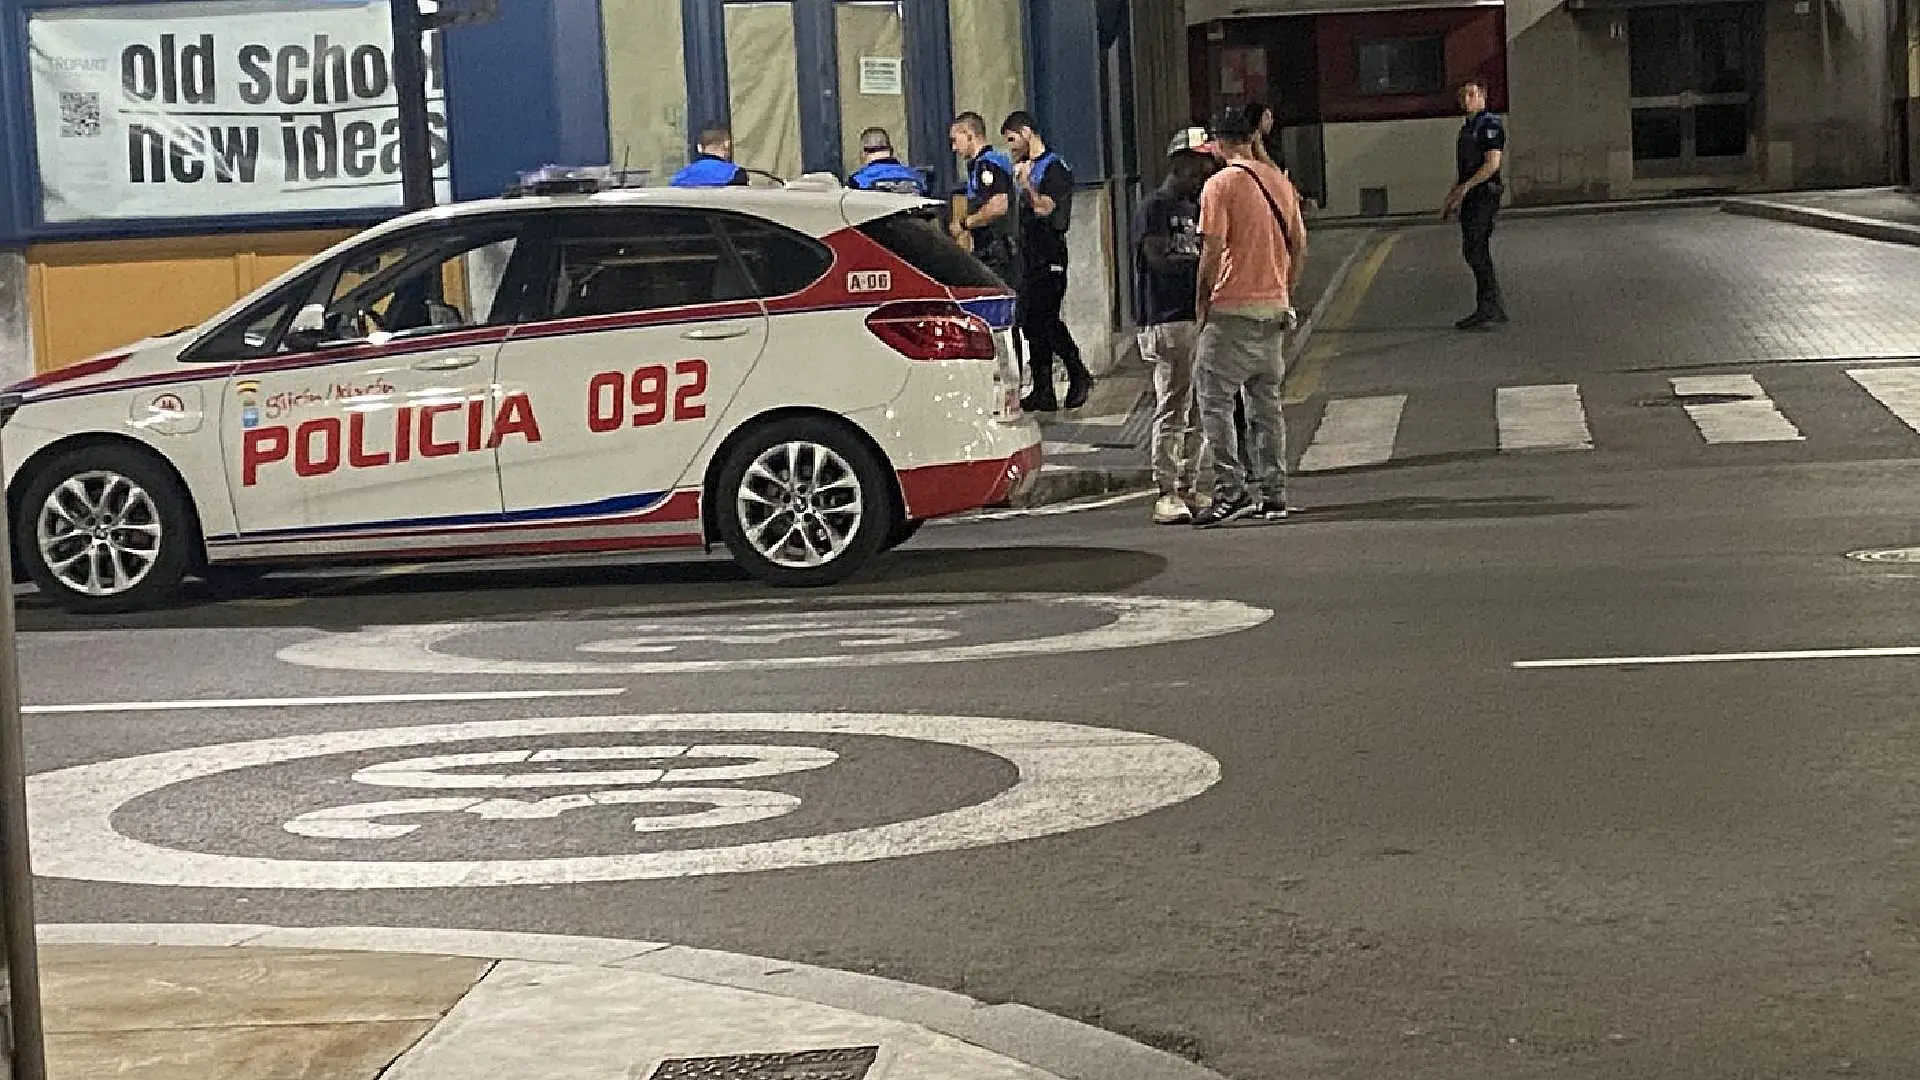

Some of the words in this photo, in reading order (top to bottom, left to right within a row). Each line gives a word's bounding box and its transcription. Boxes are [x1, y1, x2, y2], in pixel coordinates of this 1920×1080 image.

[120, 33, 216, 104] old
[238, 31, 444, 105] schol
[128, 123, 259, 183] new
[588, 358, 708, 433] 092
[242, 392, 541, 487] POLICIA
[283, 745, 840, 839] 30
